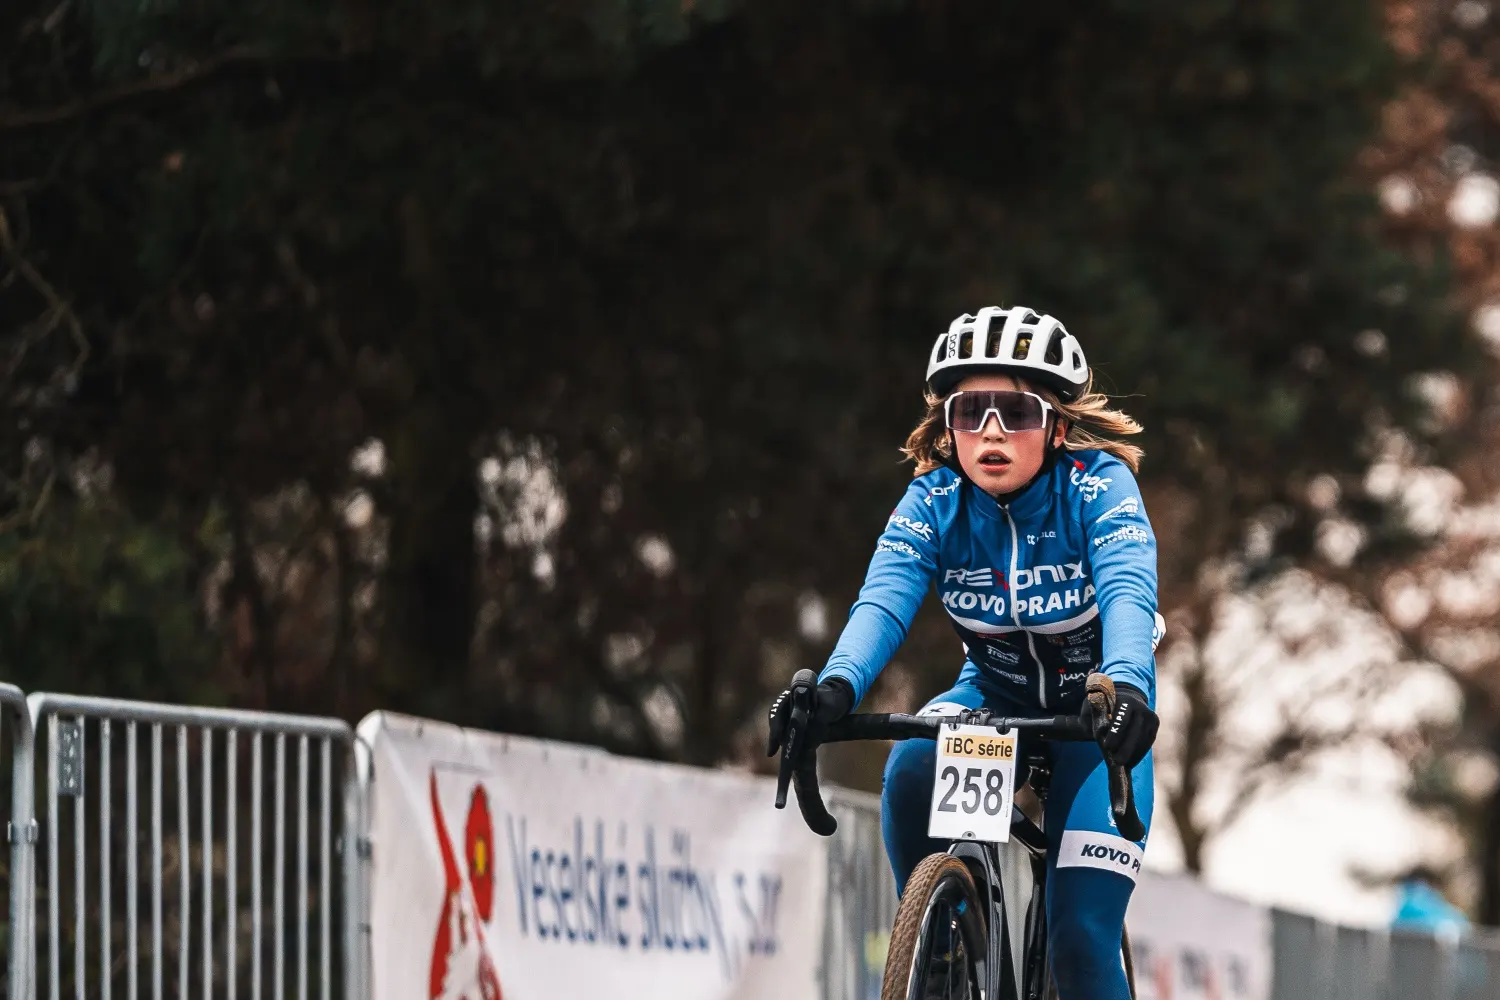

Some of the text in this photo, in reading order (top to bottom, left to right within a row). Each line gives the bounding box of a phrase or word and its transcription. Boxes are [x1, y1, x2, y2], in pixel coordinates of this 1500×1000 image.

[949, 334, 958, 358] POC
[942, 583, 1097, 618] KOVO PRAHA
[1110, 702, 1129, 734] KIPSTA
[945, 737, 1013, 758] TBC série
[937, 765, 1003, 816] 258
[1081, 843, 1131, 866] KOVO
[503, 813, 630, 948] Veselské
